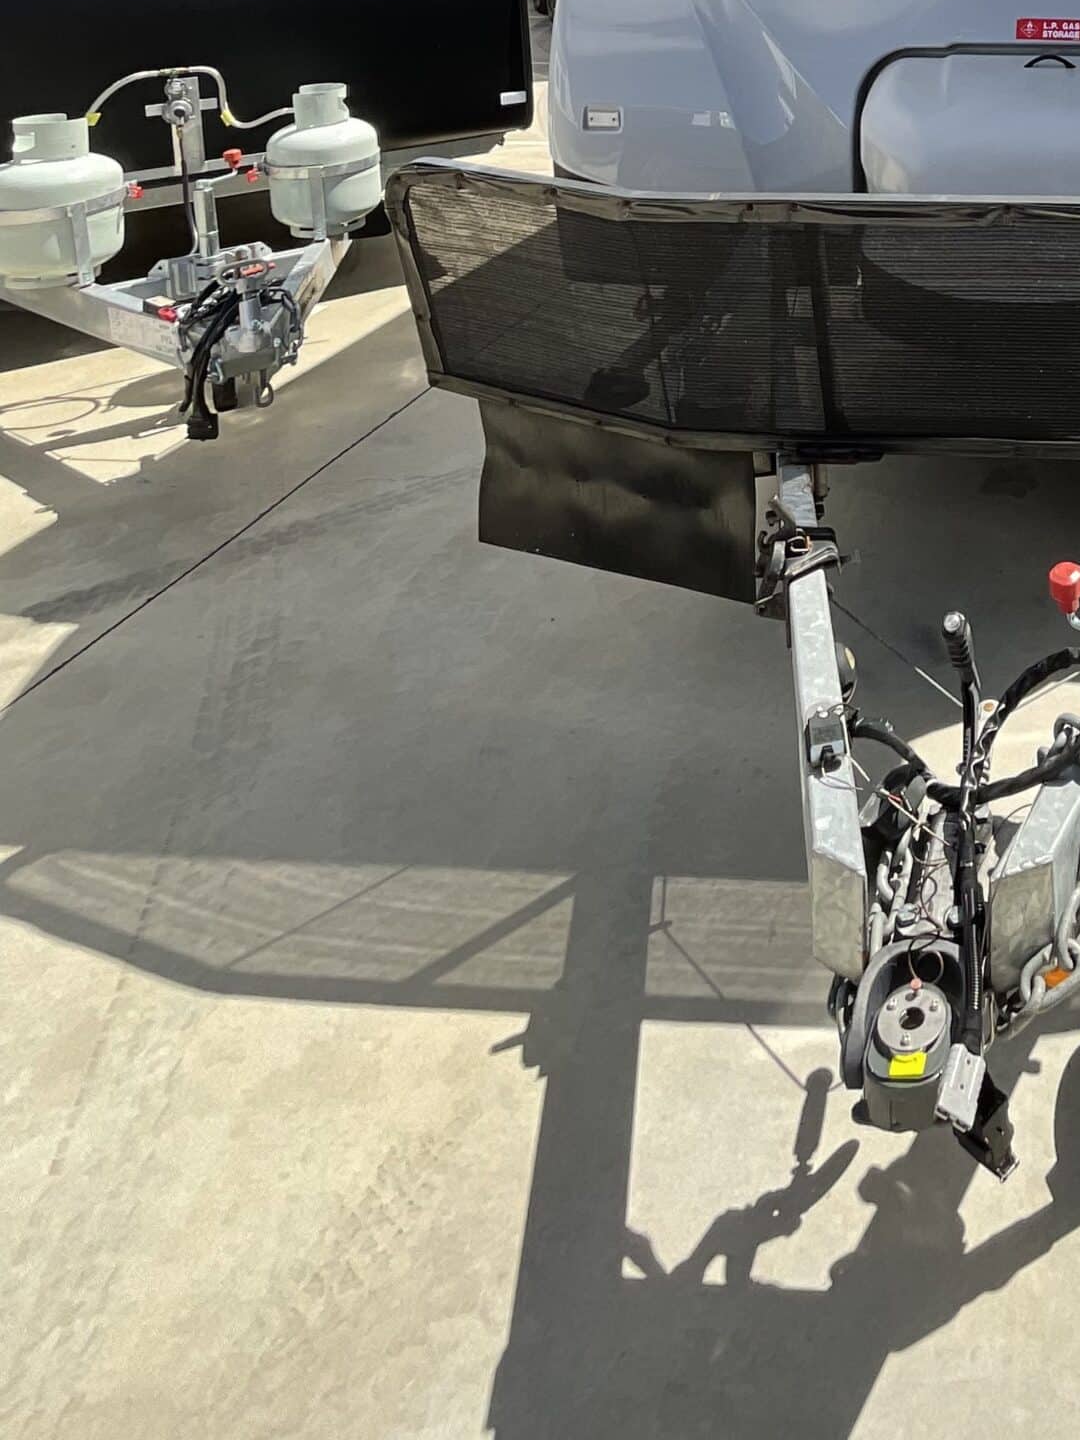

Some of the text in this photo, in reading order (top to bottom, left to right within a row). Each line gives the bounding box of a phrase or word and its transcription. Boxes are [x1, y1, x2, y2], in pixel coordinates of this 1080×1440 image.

[1043, 21, 1080, 30] L.P. GAS
[1042, 30, 1080, 39] STORAGE
